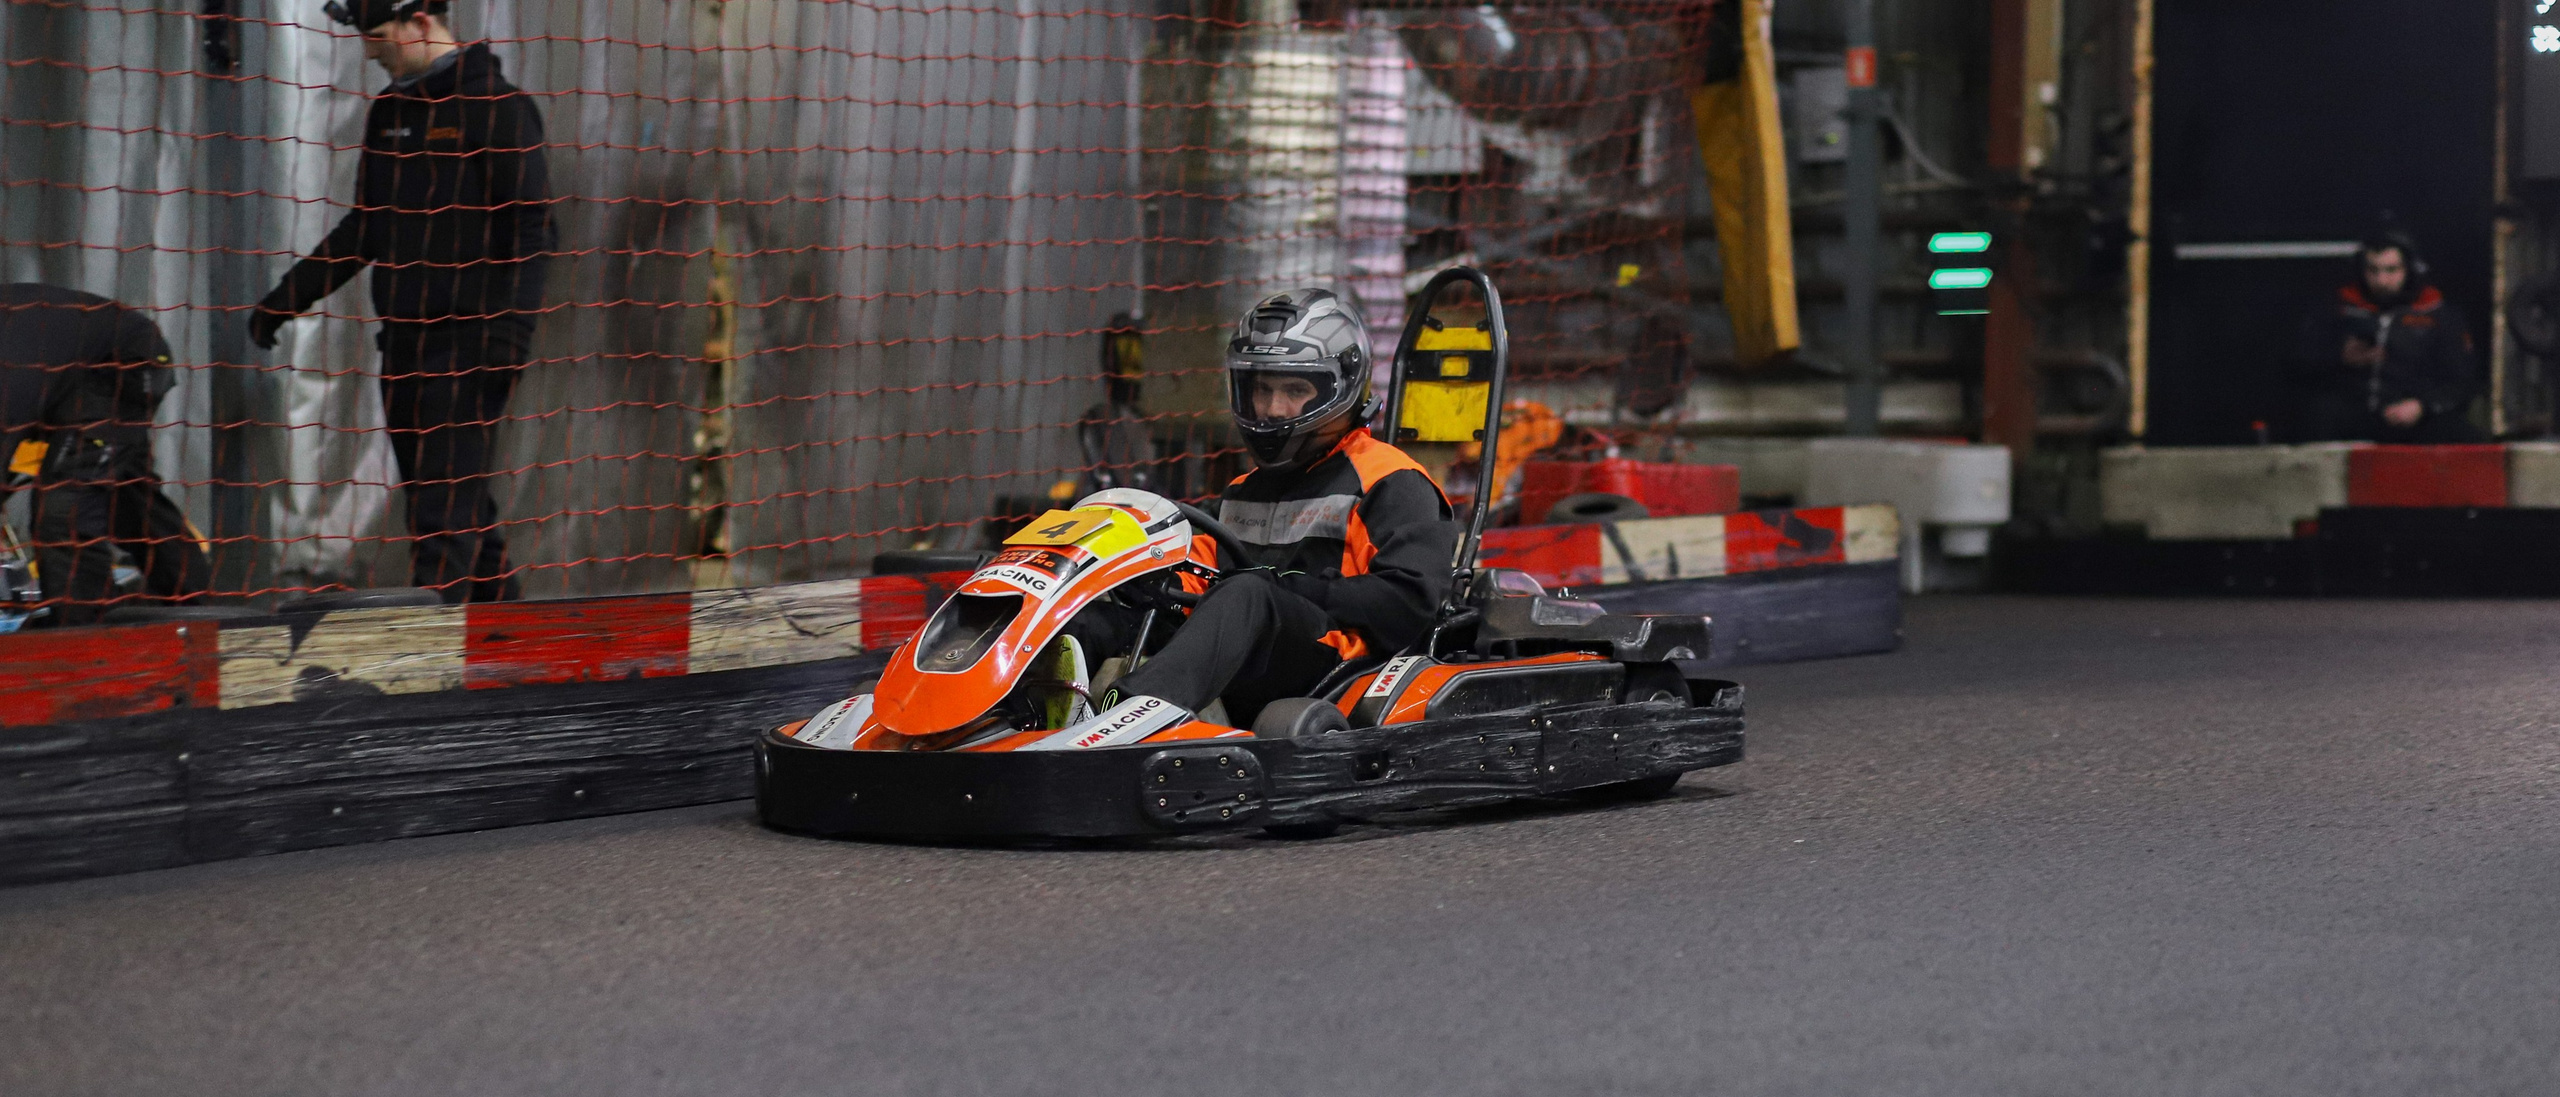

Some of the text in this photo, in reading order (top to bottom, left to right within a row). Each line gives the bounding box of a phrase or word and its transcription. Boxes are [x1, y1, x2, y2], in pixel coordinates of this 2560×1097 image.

[1241, 345, 1290, 355] LS2
[1036, 520, 1080, 538] 4
[975, 569, 1047, 591] RACING
